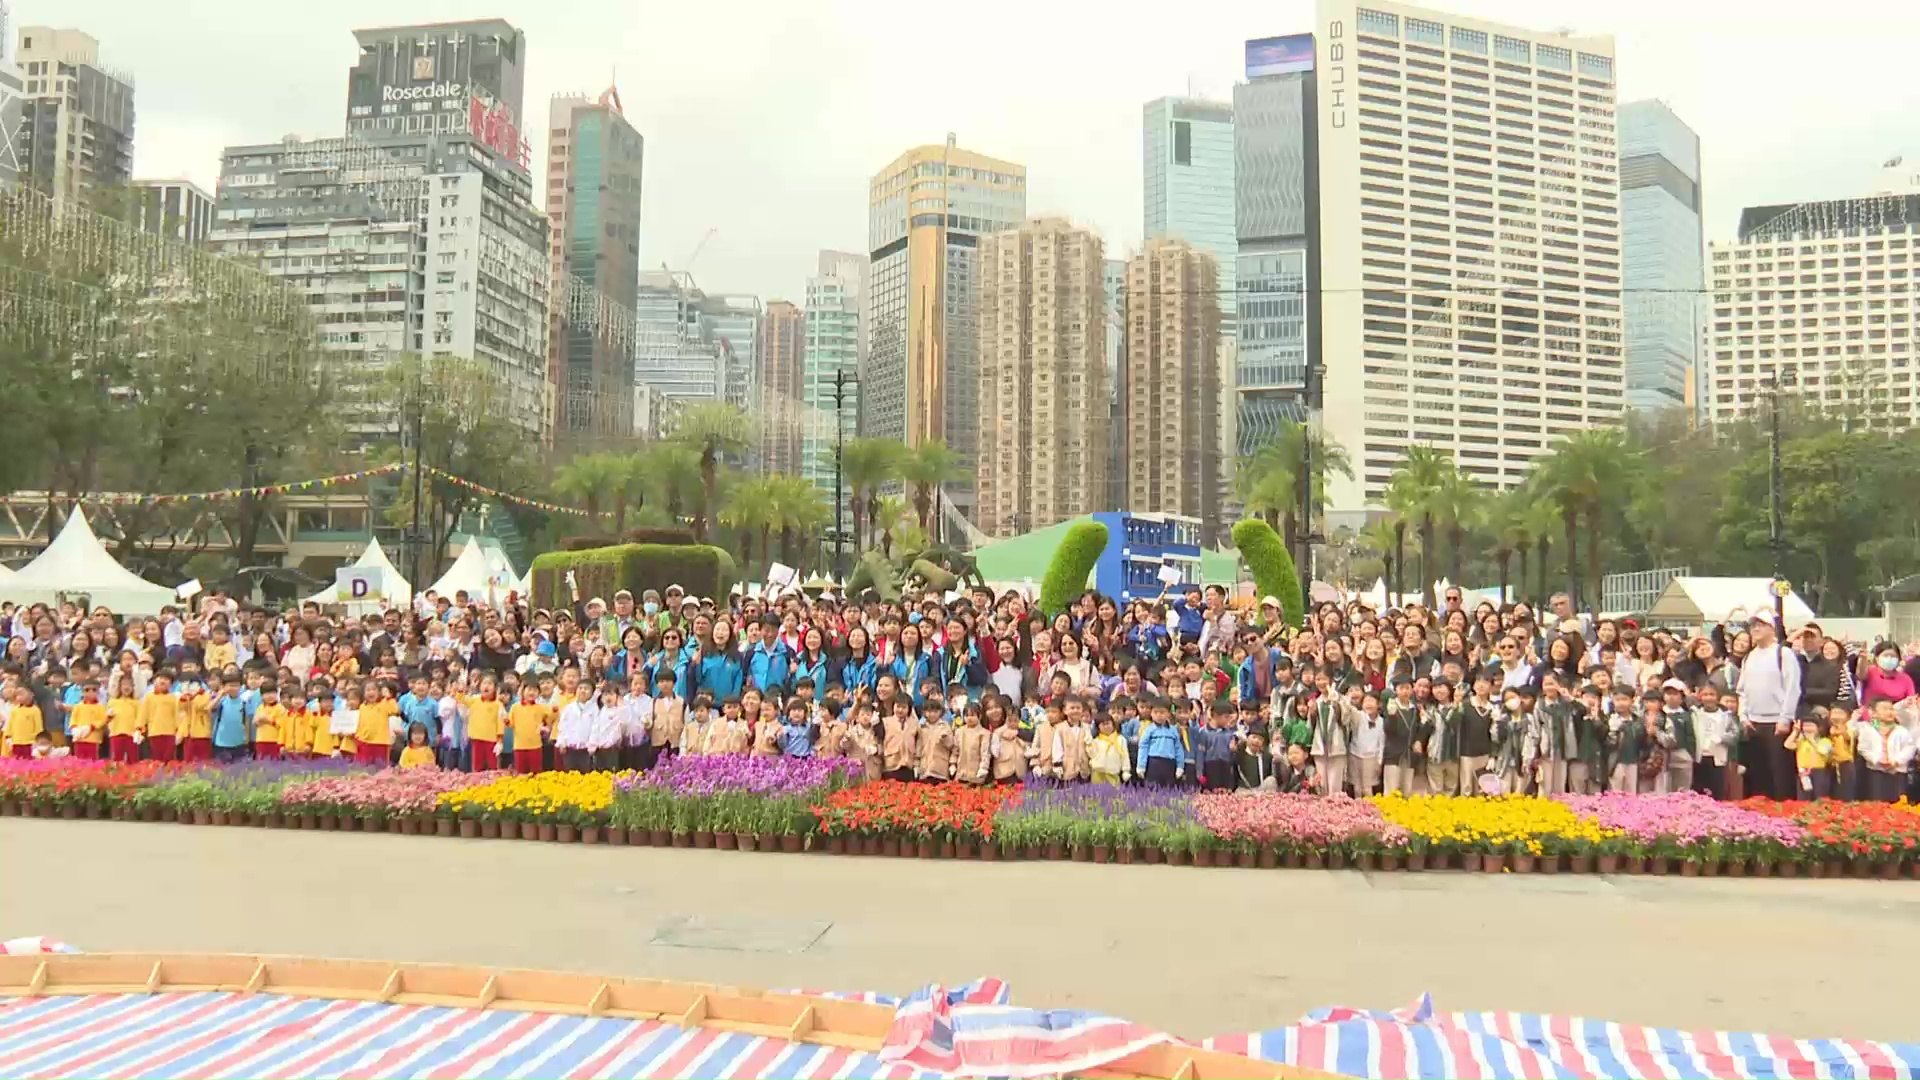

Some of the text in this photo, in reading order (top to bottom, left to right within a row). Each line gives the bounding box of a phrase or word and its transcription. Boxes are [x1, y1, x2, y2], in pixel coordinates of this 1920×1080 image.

[1330, 20, 1345, 128] CHUBB
[383, 80, 461, 101] Rosedale
[352, 578, 368, 598] D
